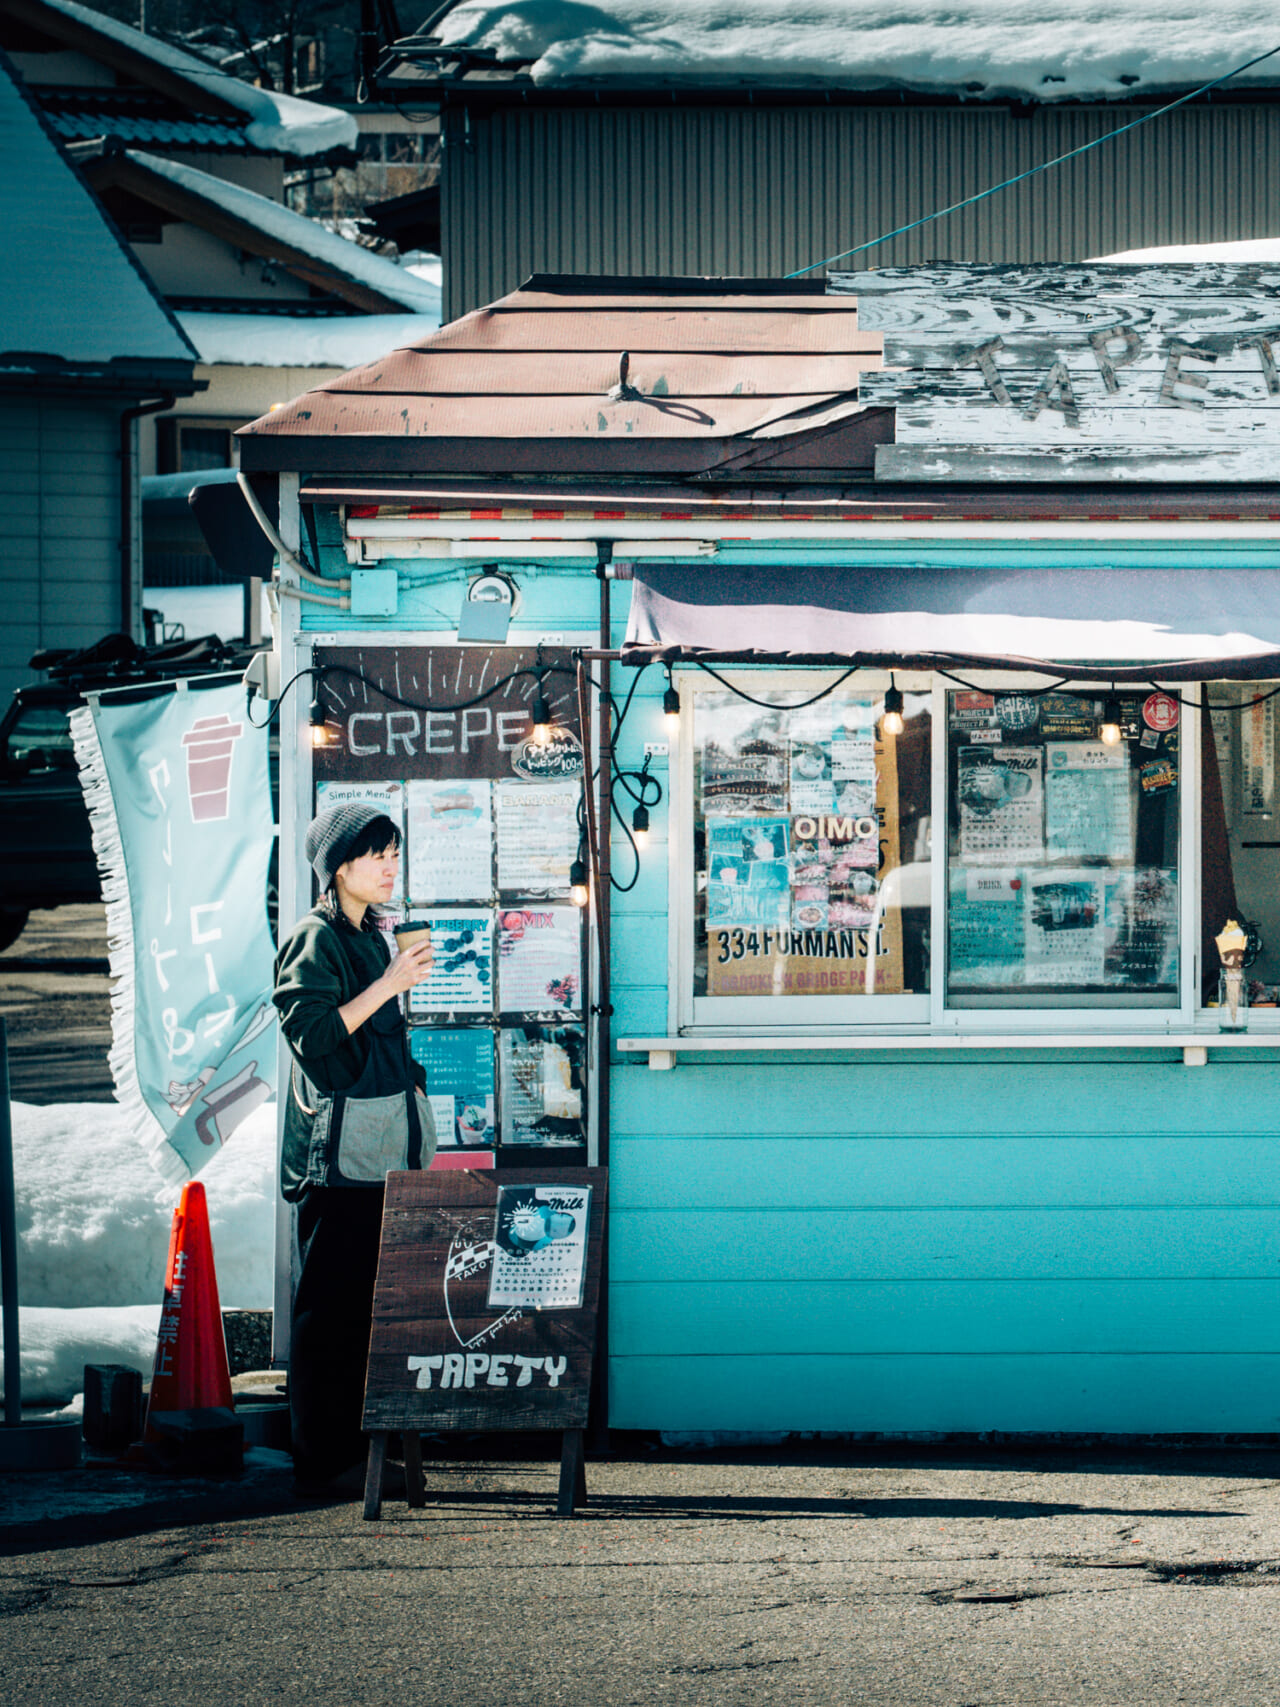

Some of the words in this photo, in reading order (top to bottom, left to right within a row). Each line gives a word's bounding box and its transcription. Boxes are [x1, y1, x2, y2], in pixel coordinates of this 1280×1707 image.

[348, 707, 530, 756] CREPE
[329, 790, 363, 801] Simple
[365, 789, 391, 800] Menu
[795, 816, 877, 840] OIMO
[413, 919, 489, 932] UEBERRY
[522, 913, 554, 928] MIX
[718, 928, 760, 964] 334
[720, 973, 793, 992] BROOKLN
[850, 969, 887, 988] PAK
[549, 1197, 584, 1210] Milk
[455, 1260, 493, 1281] TAKO
[407, 1353, 568, 1390] TAPETY
